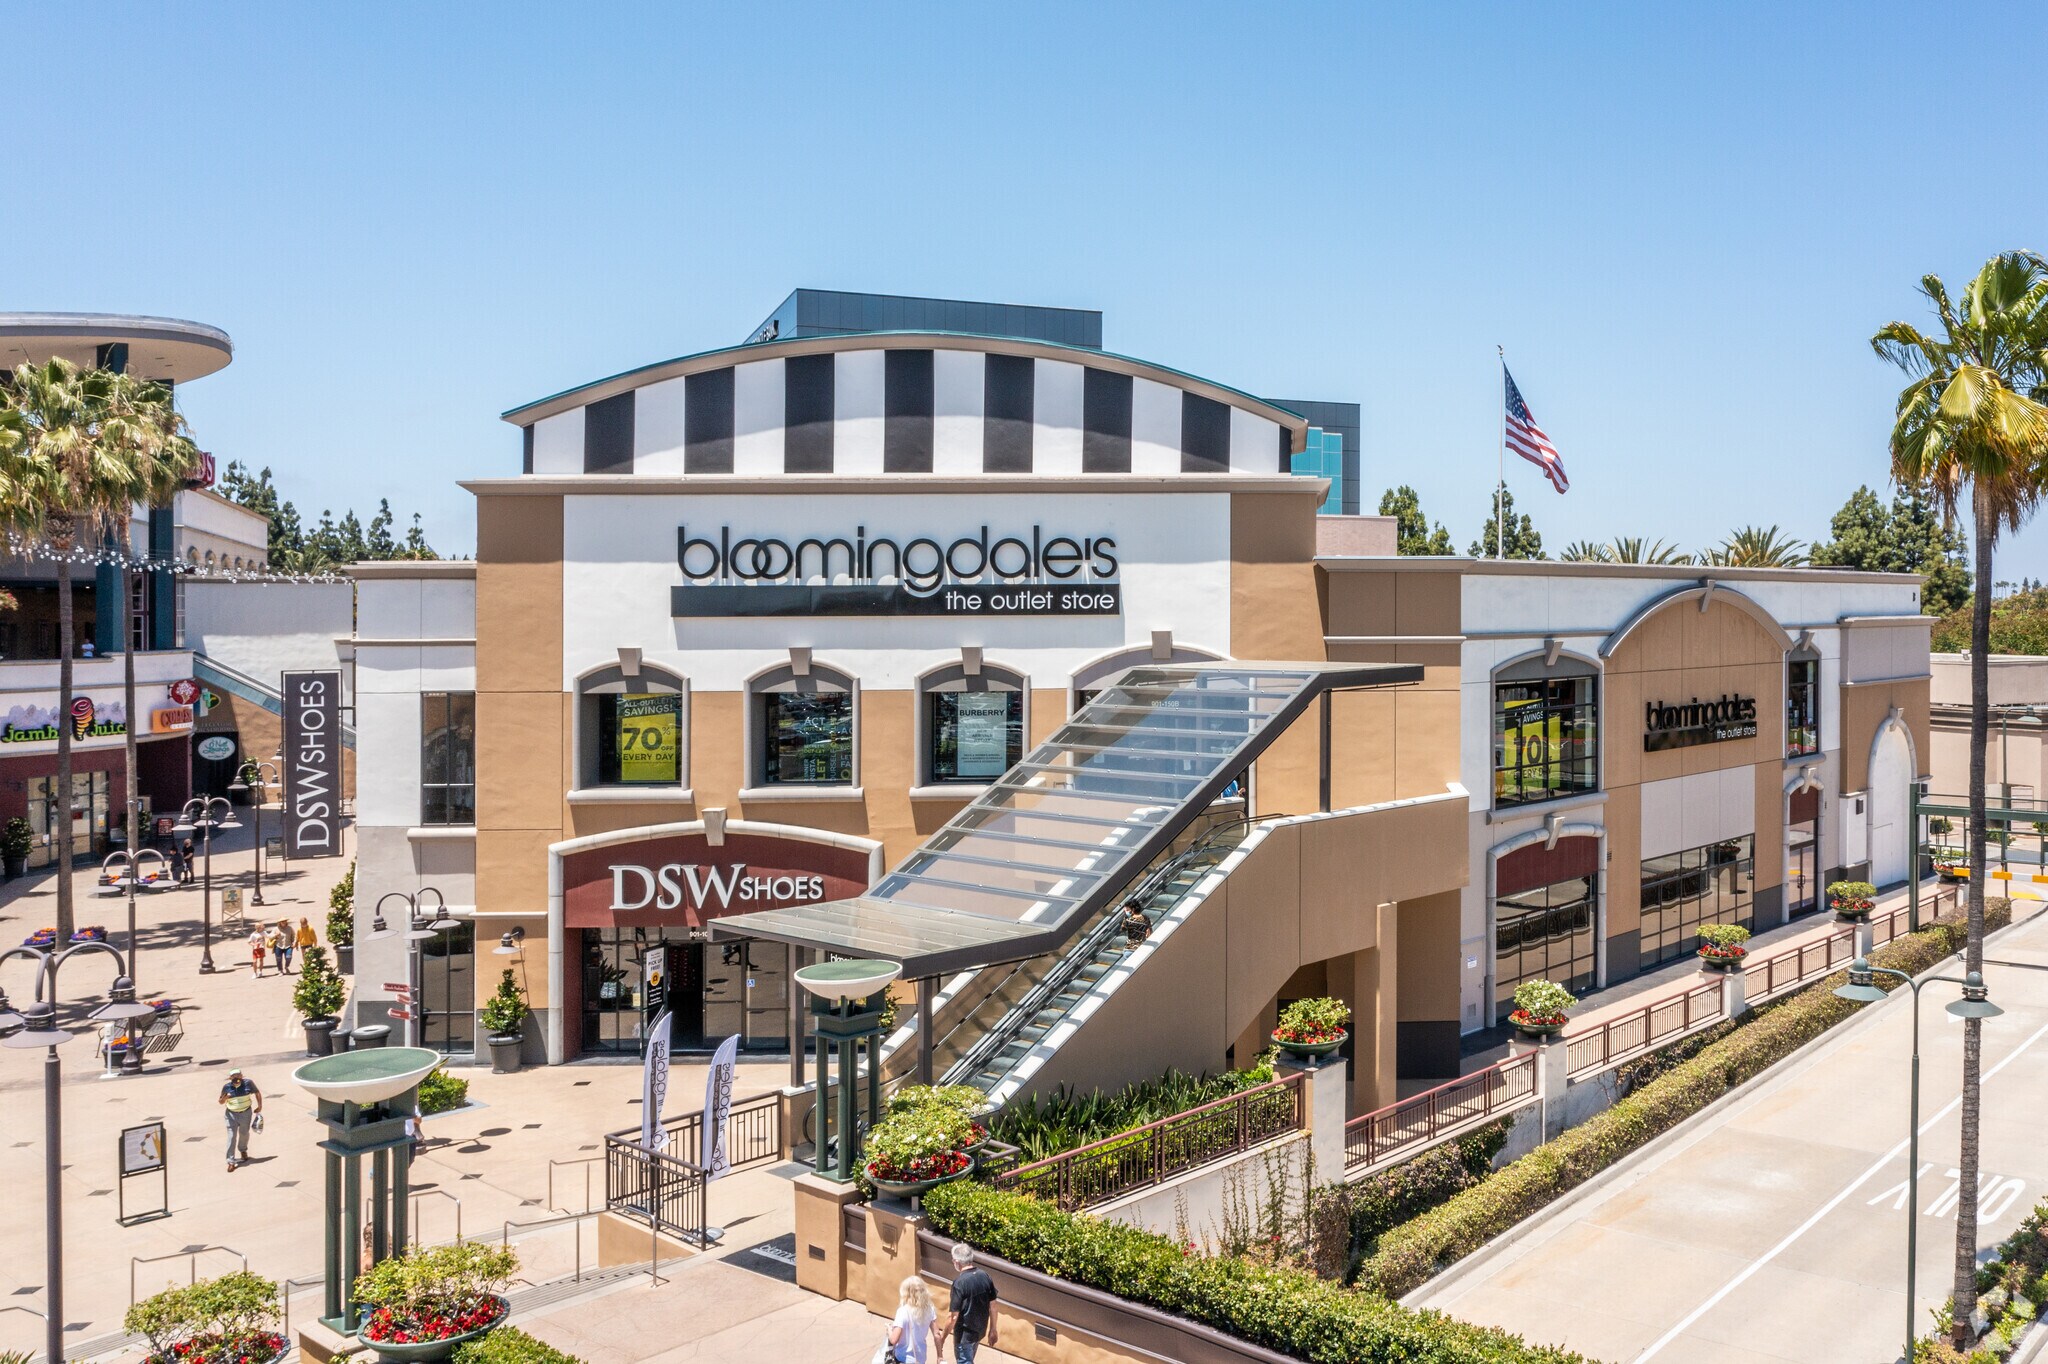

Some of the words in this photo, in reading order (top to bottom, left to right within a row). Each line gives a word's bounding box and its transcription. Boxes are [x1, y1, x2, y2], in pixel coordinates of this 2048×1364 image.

[945, 591, 982, 610] the
[990, 591, 1053, 610] outlet
[1062, 591, 1115, 610] store
[624, 704, 673, 717] SAVINGS!
[959, 709, 1005, 717] BURBERRY
[3, 724, 59, 742] jamb
[623, 727, 663, 751] 70
[608, 863, 746, 910] DSW
[739, 876, 823, 900] SHOES
